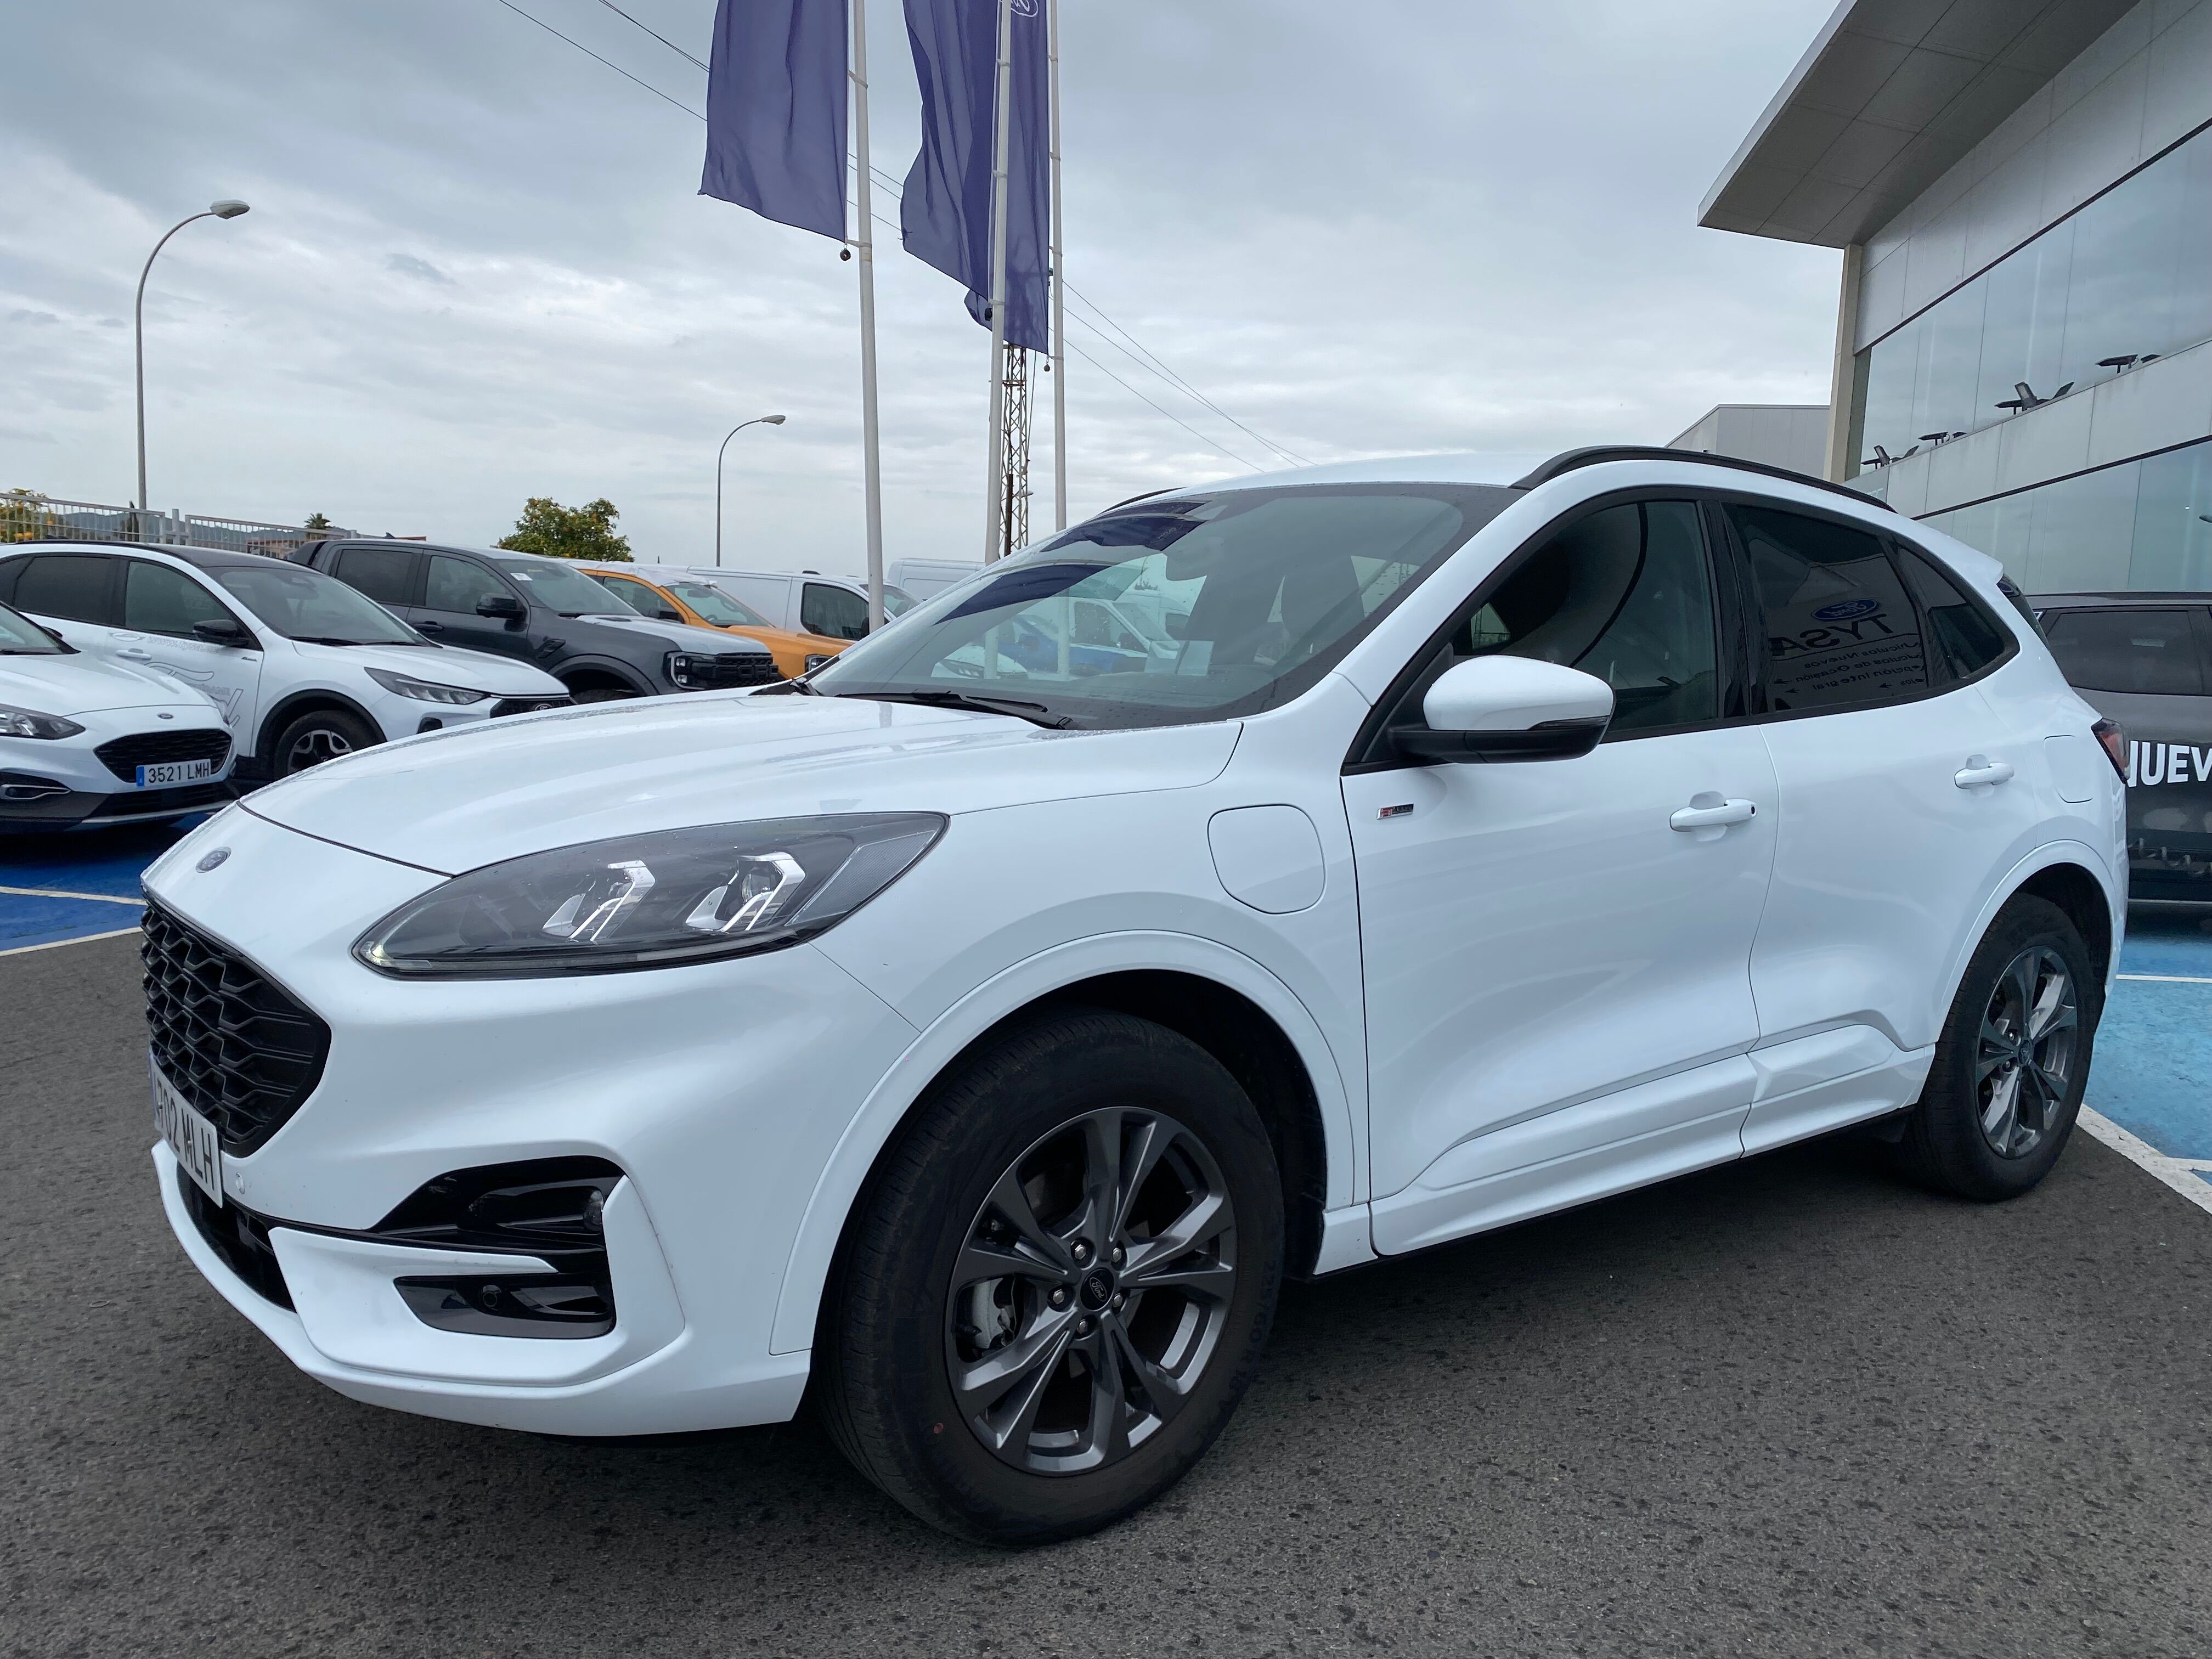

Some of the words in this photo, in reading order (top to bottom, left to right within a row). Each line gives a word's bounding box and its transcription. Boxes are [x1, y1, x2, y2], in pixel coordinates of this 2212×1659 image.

[149, 765, 181, 783] 3521
[188, 762, 210, 780] LMH
[181, 1108, 215, 1191] MLH
[1091, 1280, 1105, 1299] Ford
